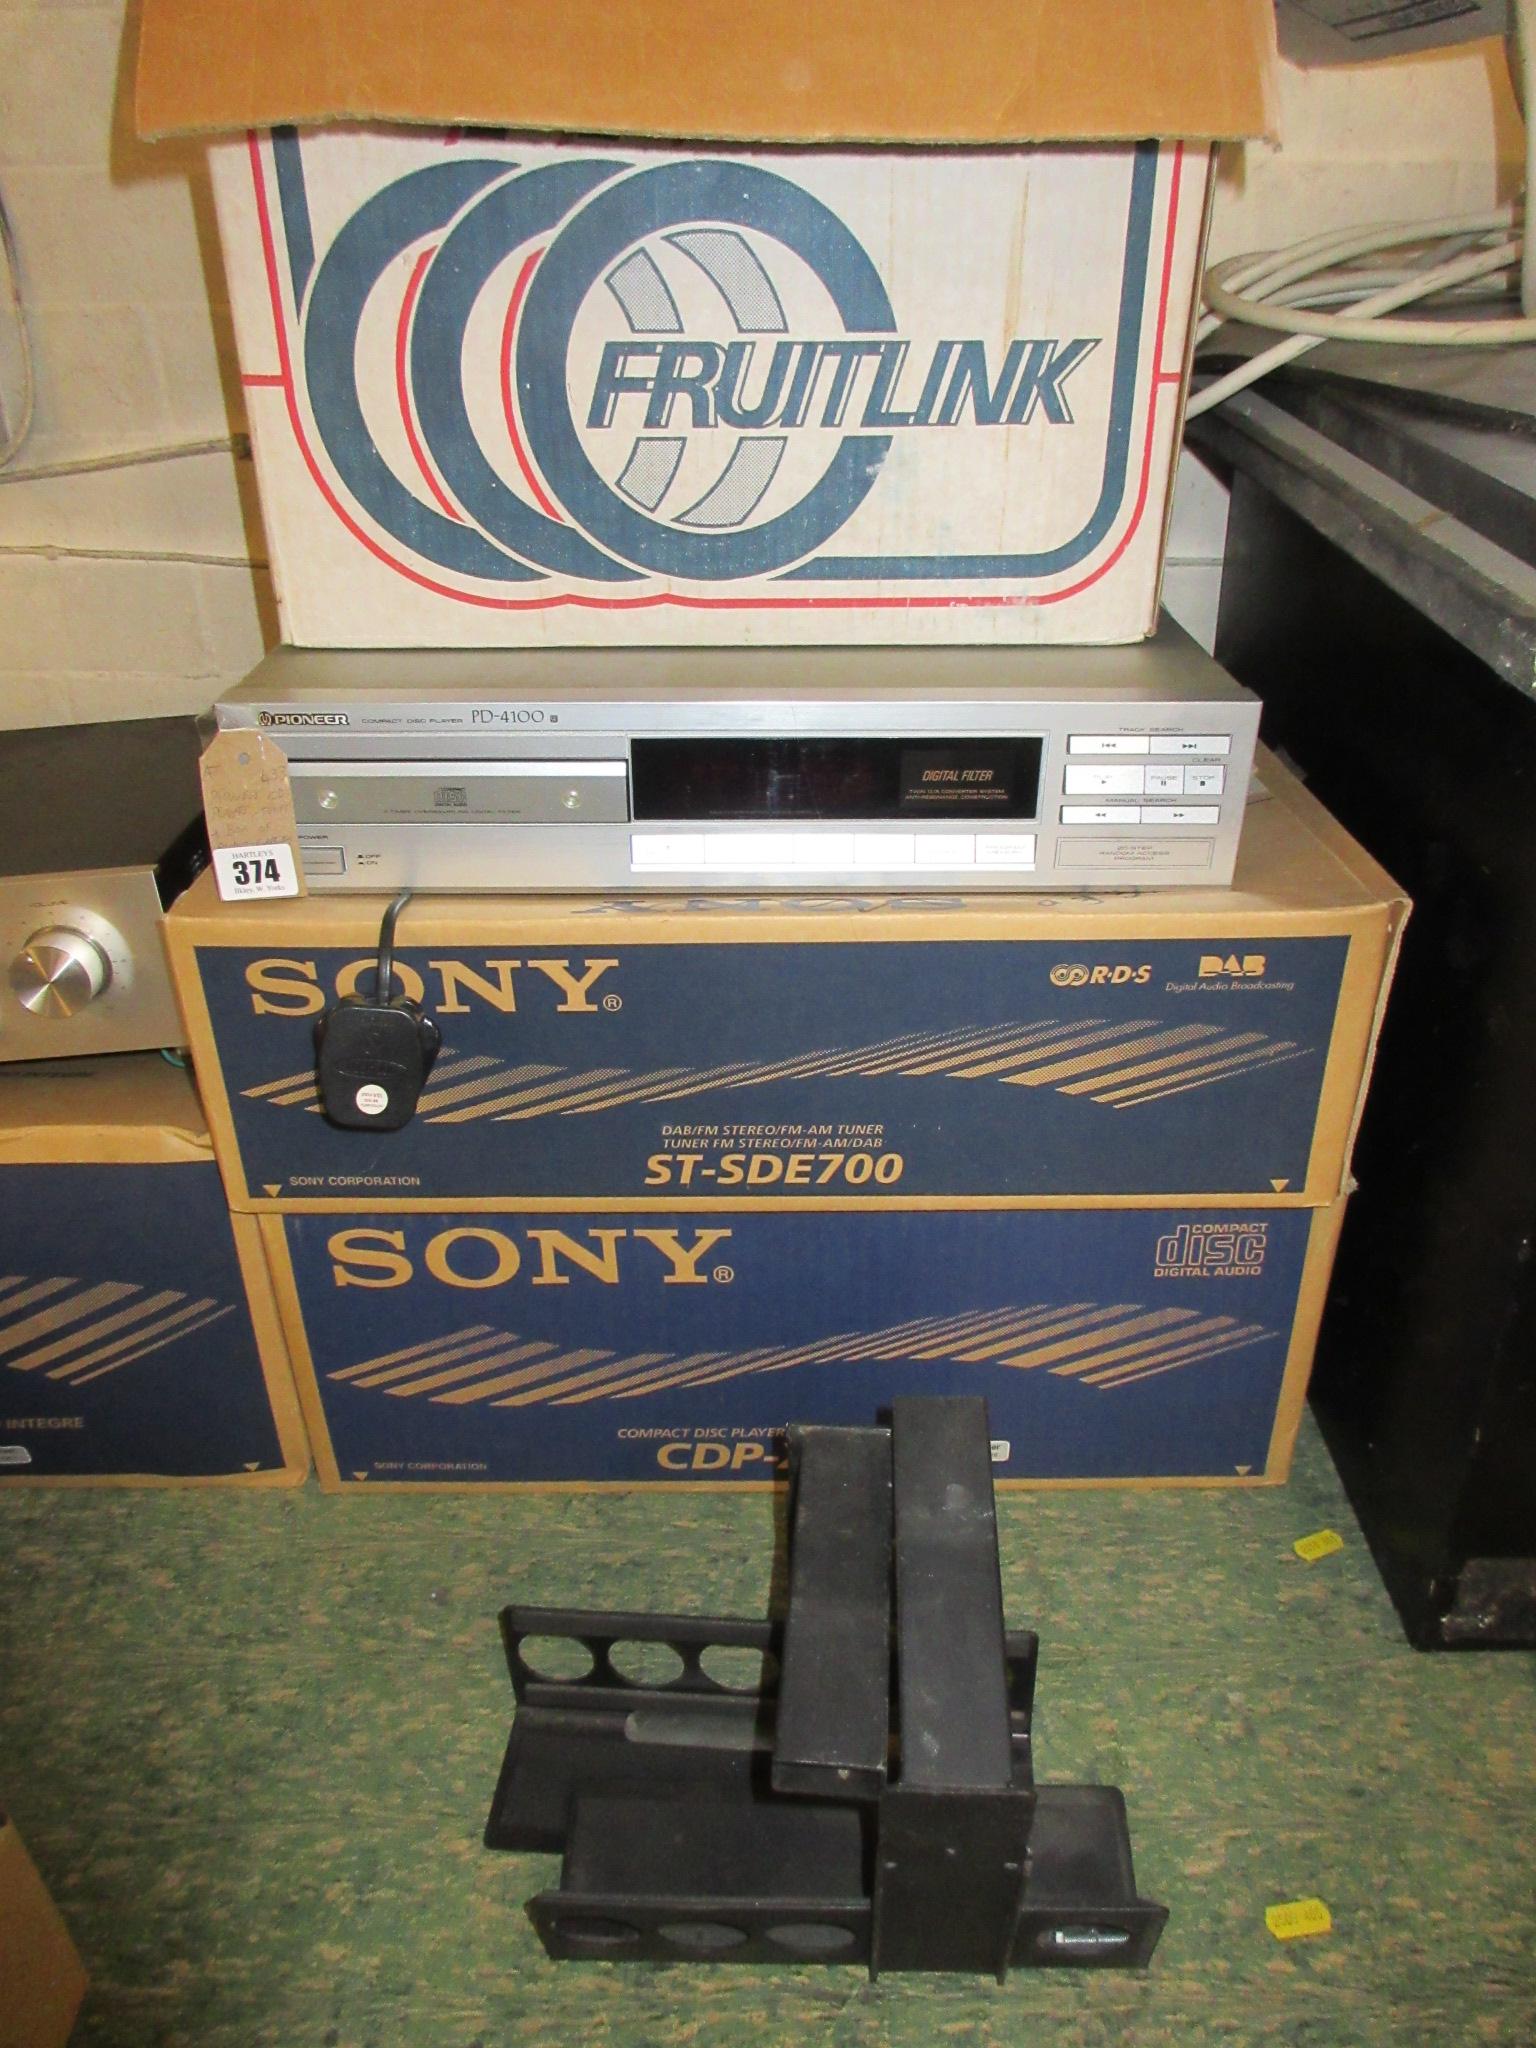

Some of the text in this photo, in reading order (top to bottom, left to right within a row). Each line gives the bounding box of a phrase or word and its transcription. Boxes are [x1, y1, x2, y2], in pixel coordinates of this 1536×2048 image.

[585, 338, 1102, 430] FRUITLINK
[274, 713, 349, 726] PIONEER
[471, 709, 545, 724] PD-4100
[922, 770, 994, 781] DIGITAL FILTER
[232, 858, 281, 886] 374
[1198, 954, 1266, 977] DAB
[1165, 980, 1296, 994] Digital Audio Broadcasting
[661, 1124, 885, 1136] DAB/FM STEREO/FM-AM TUNER
[662, 1138, 884, 1149] TUNER FM STEREO/FM-AM/DAB
[644, 1152, 904, 1186] ST-SDE700
[288, 1176, 421, 1186] SONY CORPORATION
[1191, 1222, 1269, 1234] COMPACT
[327, 1227, 733, 1288] SONY
[1153, 1265, 1263, 1278] DIGITAL AUDIO
[617, 1427, 786, 1439] COMPACT DISC PLAYER
[373, 1462, 488, 1470] SONY CORPORATION
